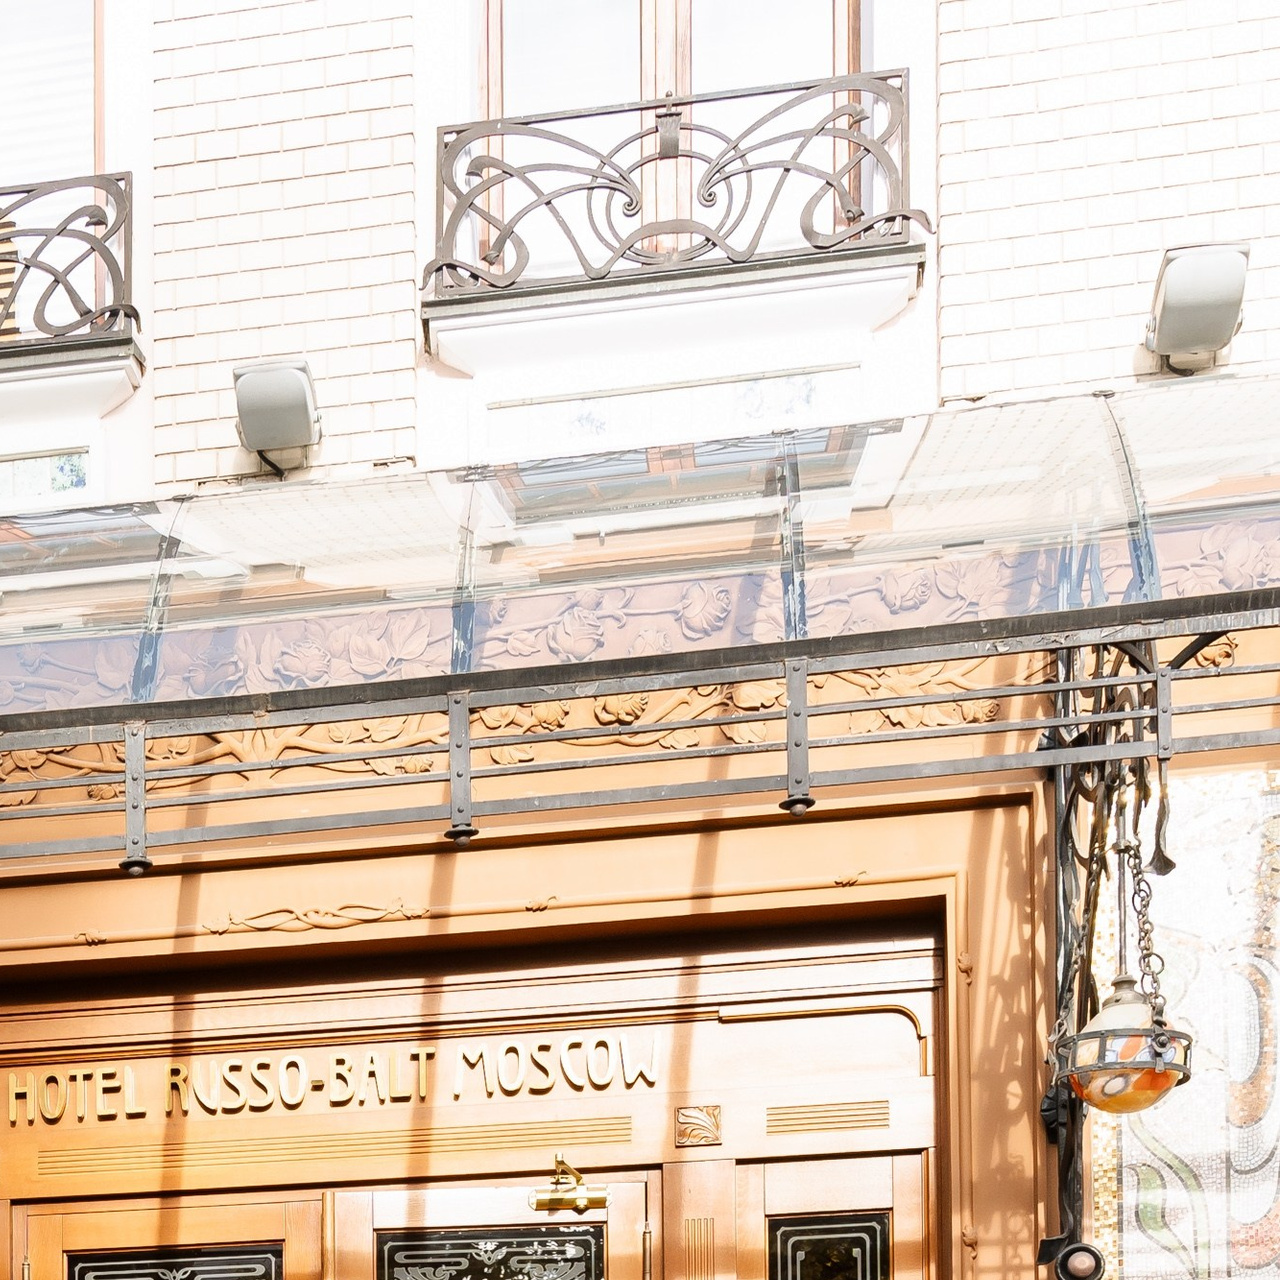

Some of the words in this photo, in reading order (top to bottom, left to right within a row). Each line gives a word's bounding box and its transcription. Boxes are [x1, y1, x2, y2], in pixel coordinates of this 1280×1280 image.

[8, 1065, 147, 1128] HOTEL
[164, 1046, 436, 1117] RUSSO-BALT
[453, 1030, 662, 1101] MOSCOW
